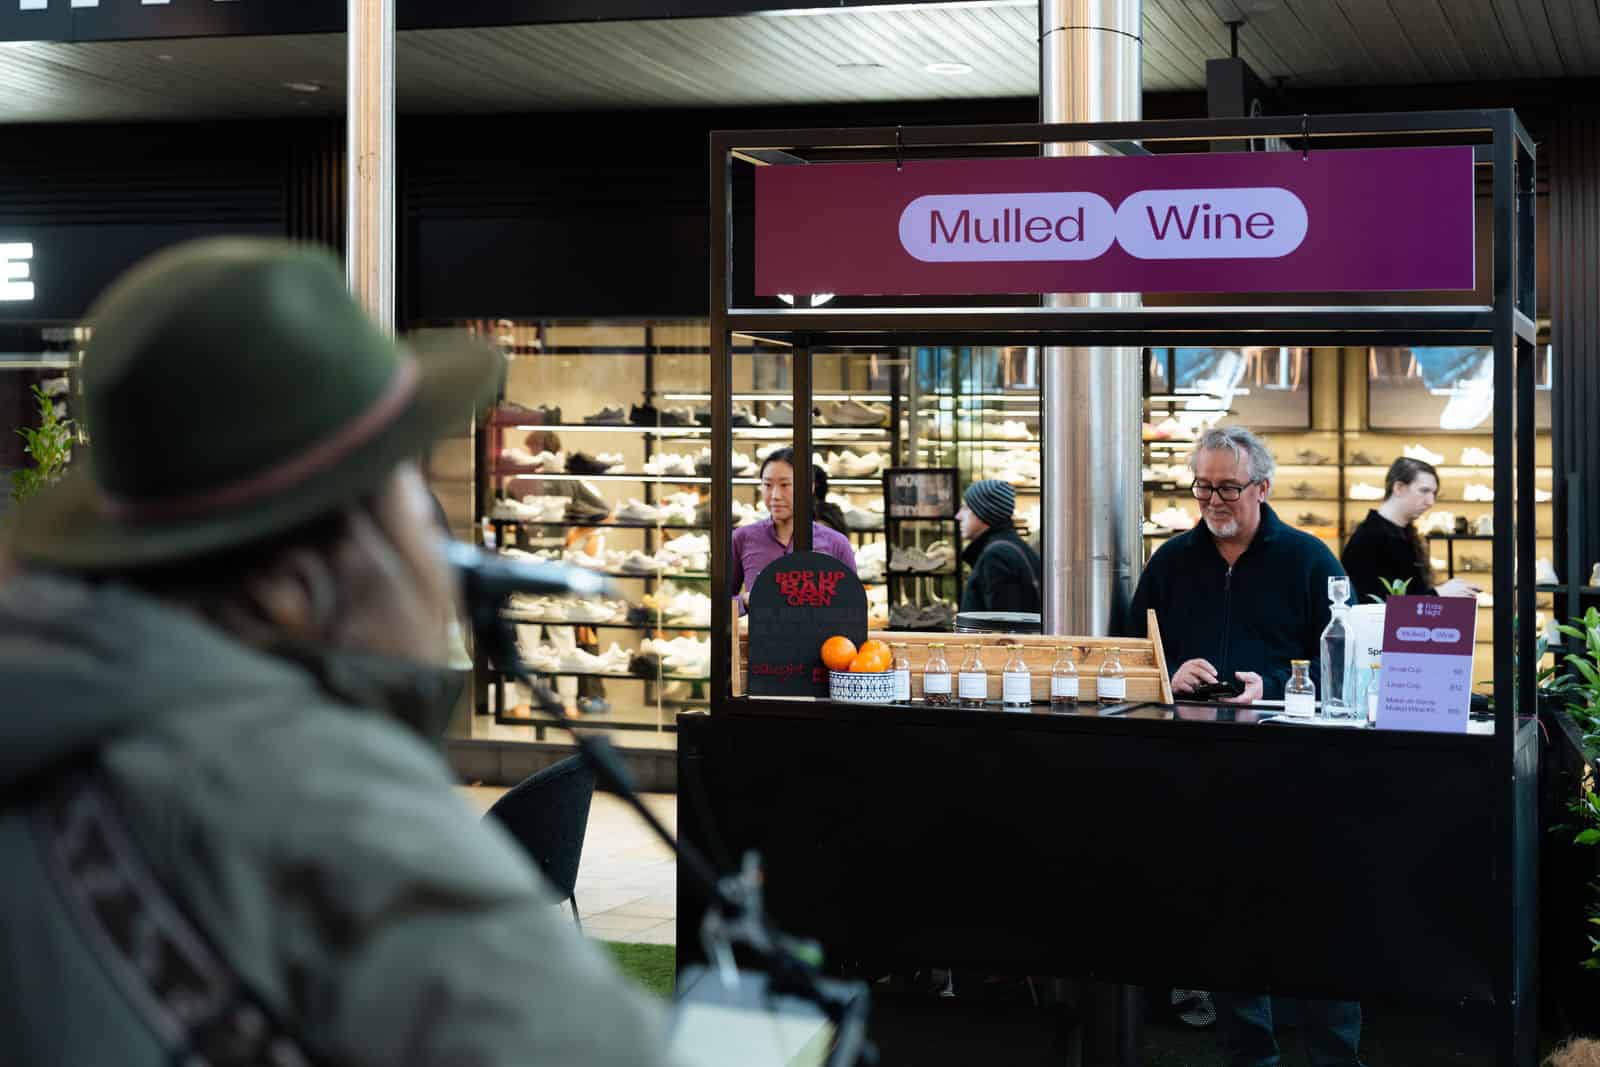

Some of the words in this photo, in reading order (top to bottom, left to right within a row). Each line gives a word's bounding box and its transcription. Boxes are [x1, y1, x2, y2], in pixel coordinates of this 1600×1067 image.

[929, 206, 1085, 244] Mulled
[1146, 203, 1275, 241] Wine
[0, 242, 35, 301] E
[818, 569, 846, 583] UP
[780, 580, 838, 595] BAR
[786, 592, 832, 607] OPEN
